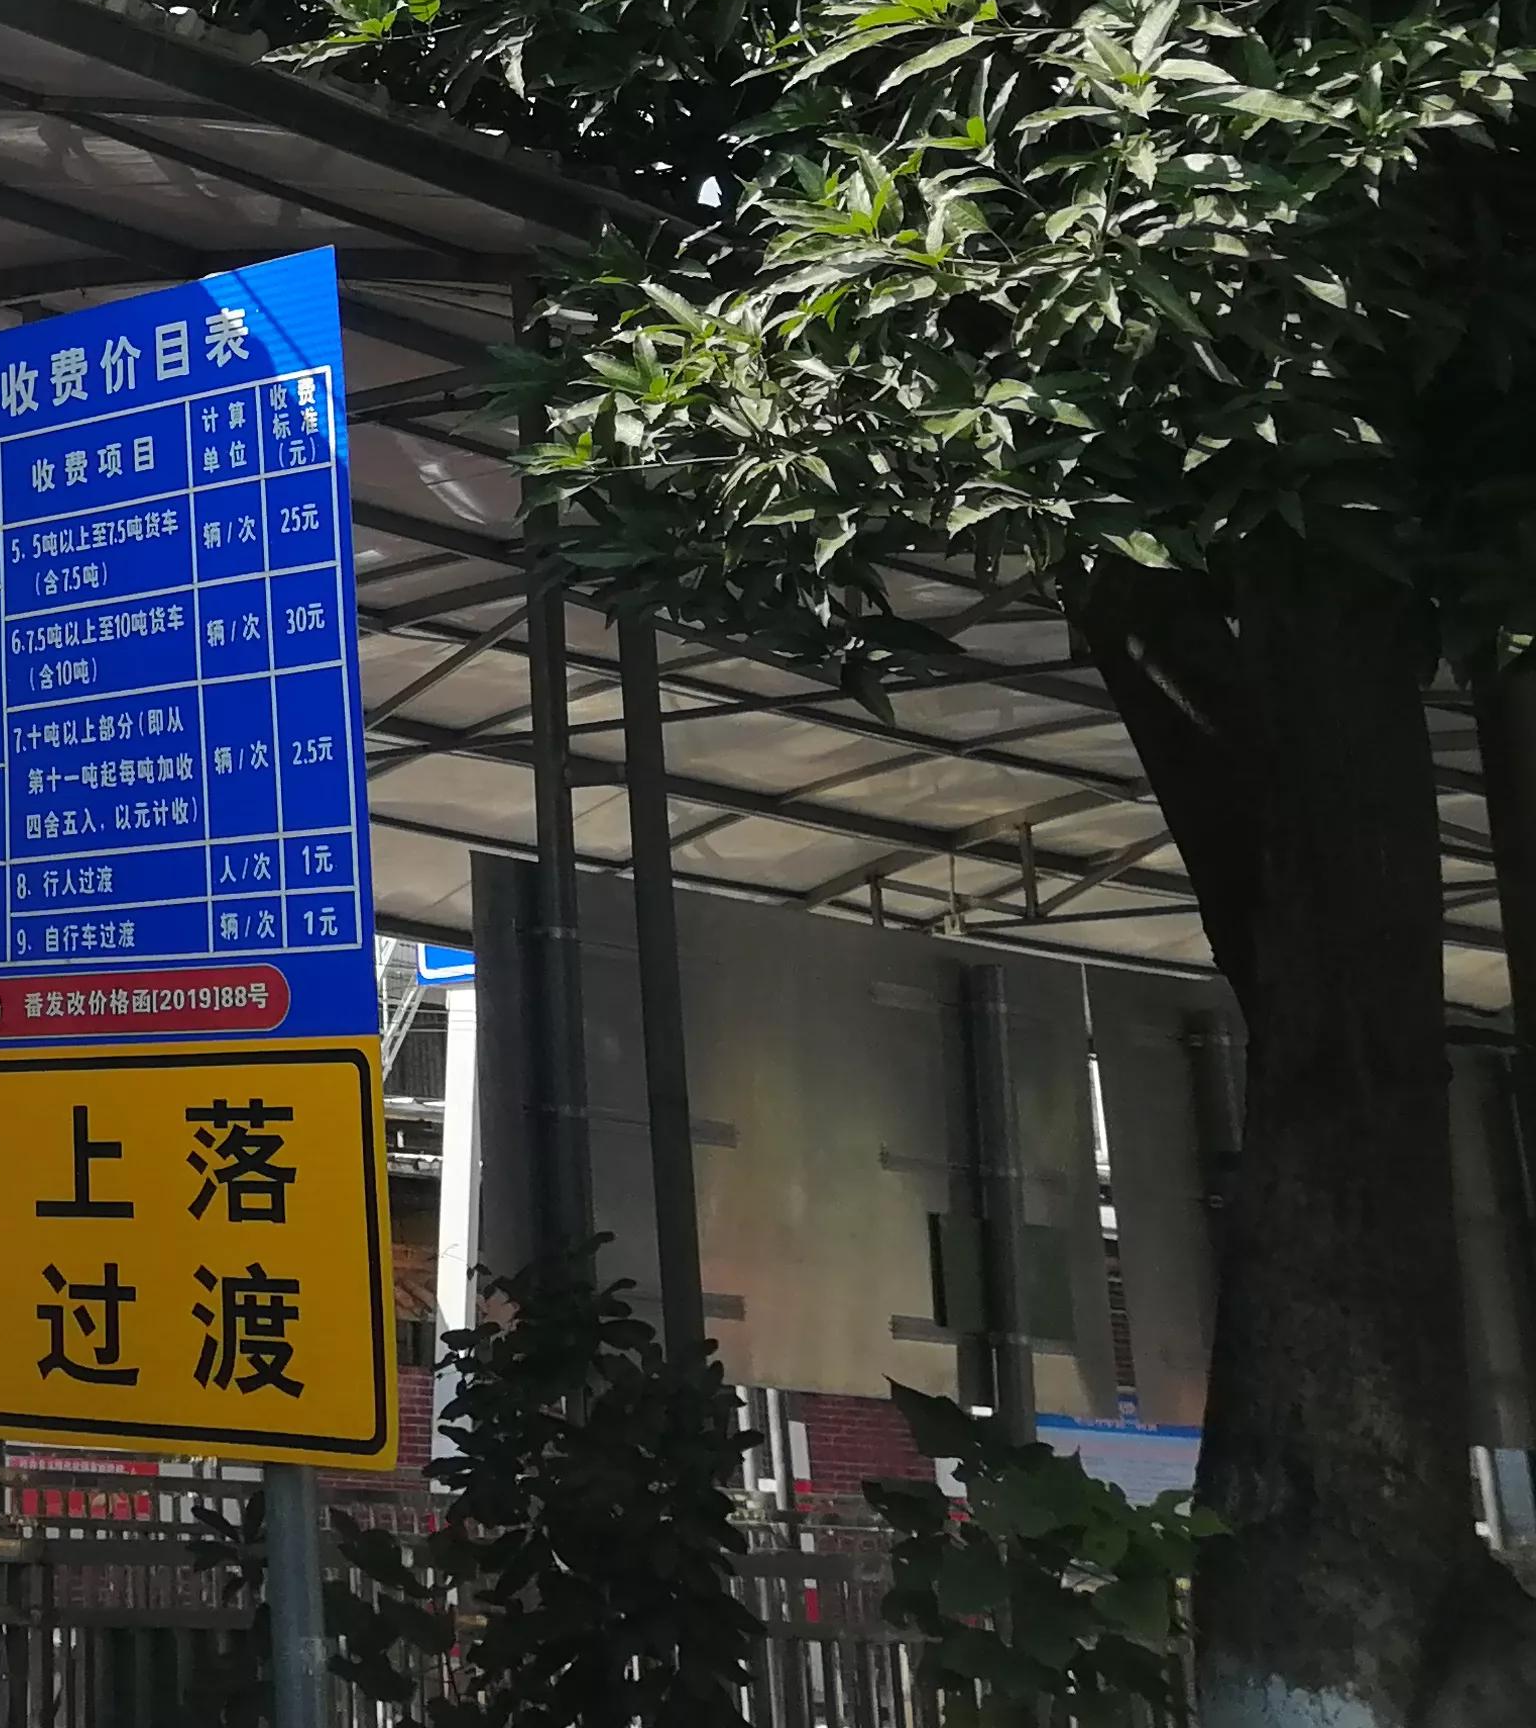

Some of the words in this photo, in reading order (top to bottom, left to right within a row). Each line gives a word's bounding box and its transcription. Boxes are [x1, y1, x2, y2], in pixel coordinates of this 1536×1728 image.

[270, 378, 315, 410] 收费
[202, 401, 246, 433] 计算
[272, 407, 319, 440] 标准
[31, 436, 154, 492] 收费项目
[203, 441, 246, 473] 单位
[203, 515, 256, 550] 辆/次
[280, 503, 319, 534] 25元
[207, 613, 260, 647] 辆/次
[286, 602, 325, 635] 30元
[214, 740, 269, 775] 辆/次
[292, 736, 333, 765] 2.5元
[28, 753, 194, 796] 第十一吨起每吨加收
[220, 852, 271, 883] 人/次
[302, 845, 333, 875] 1元
[220, 910, 275, 940] 辆/次
[304, 907, 338, 936] 1元
